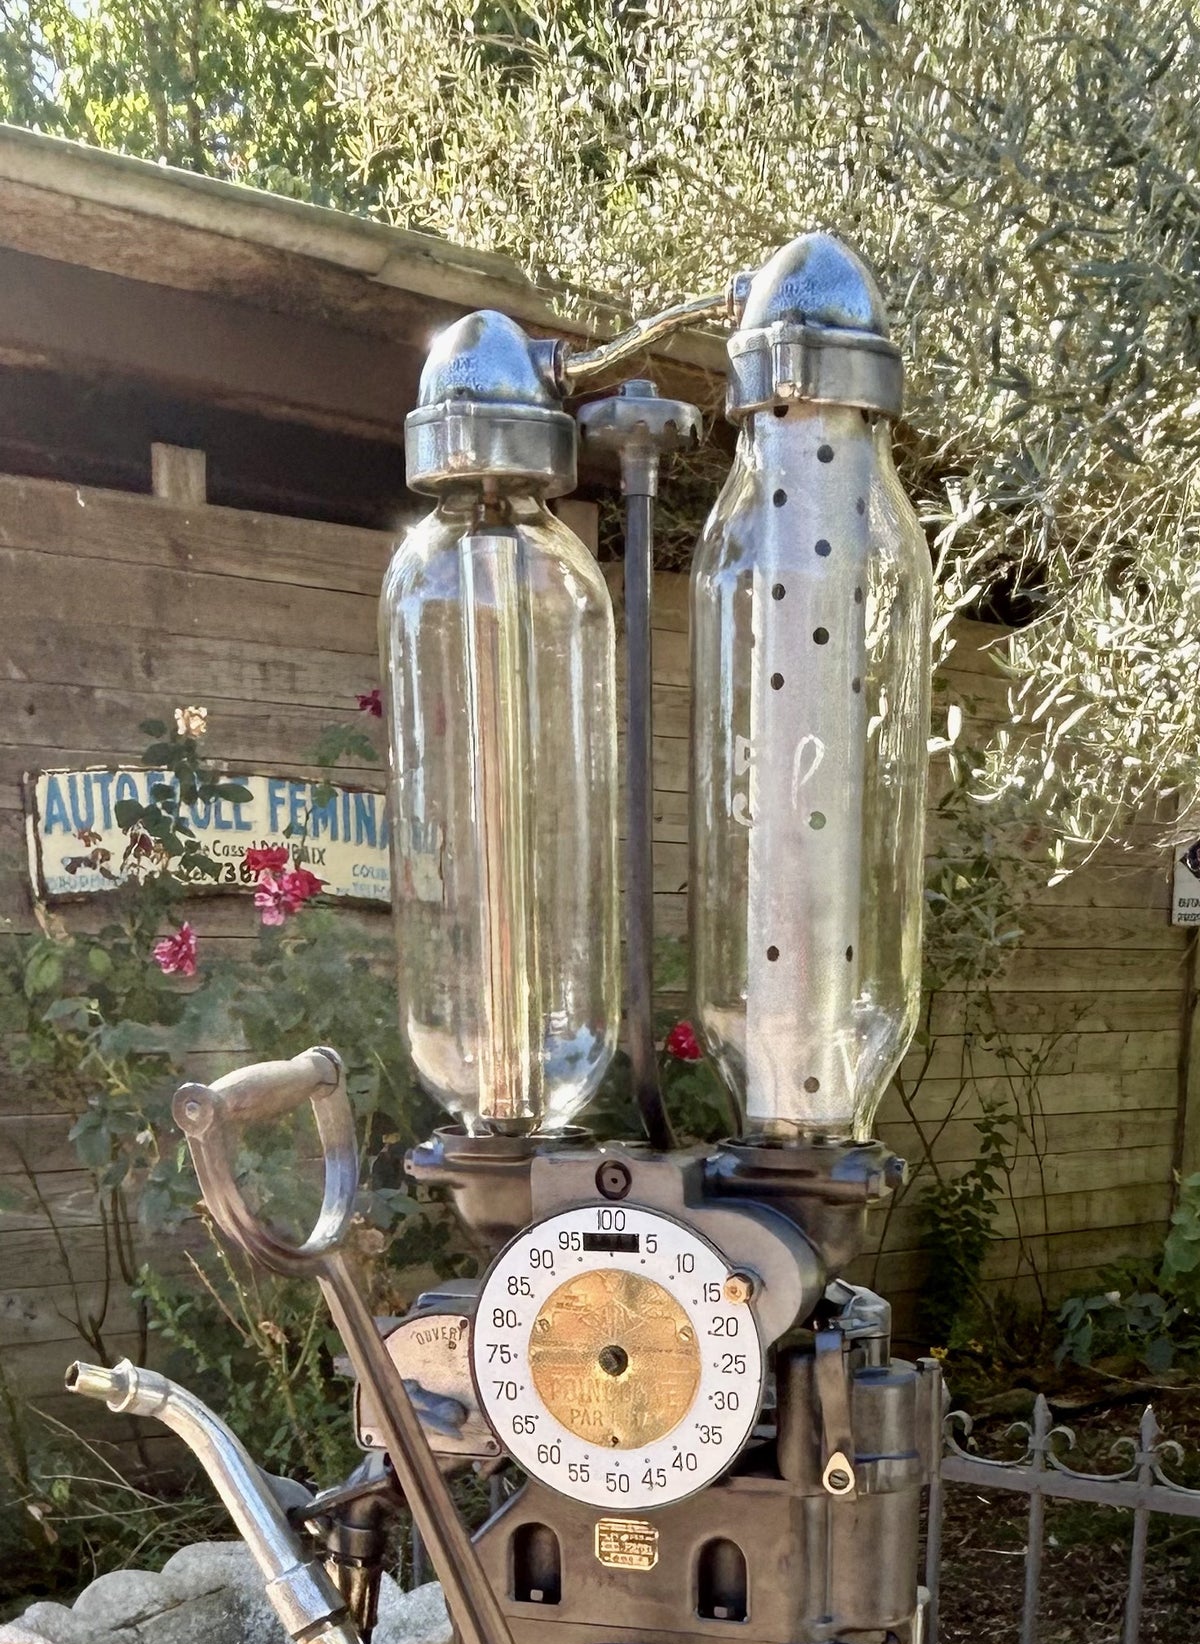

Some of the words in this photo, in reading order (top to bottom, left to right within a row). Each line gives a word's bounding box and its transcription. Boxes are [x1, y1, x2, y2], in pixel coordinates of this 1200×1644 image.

[595, 1209, 627, 1232] 100
[559, 1231, 581, 1252] 95
[645, 1233, 658, 1254] 5
[529, 1248, 555, 1270] 90
[676, 1252, 695, 1274] 10
[507, 1276, 531, 1296] 85
[703, 1283, 721, 1303] 15
[493, 1308, 517, 1328] 80
[712, 1317, 739, 1337] 20
[486, 1343, 511, 1365] 75
[721, 1353, 747, 1375] 25
[493, 1380, 518, 1401] 70
[714, 1390, 739, 1411] 30
[512, 1414, 536, 1435] 65
[699, 1424, 722, 1445] 35
[537, 1444, 561, 1465] 60
[671, 1451, 698, 1472] 40
[568, 1463, 590, 1483] 55
[605, 1472, 630, 1494] 50
[641, 1467, 668, 1489] 45
